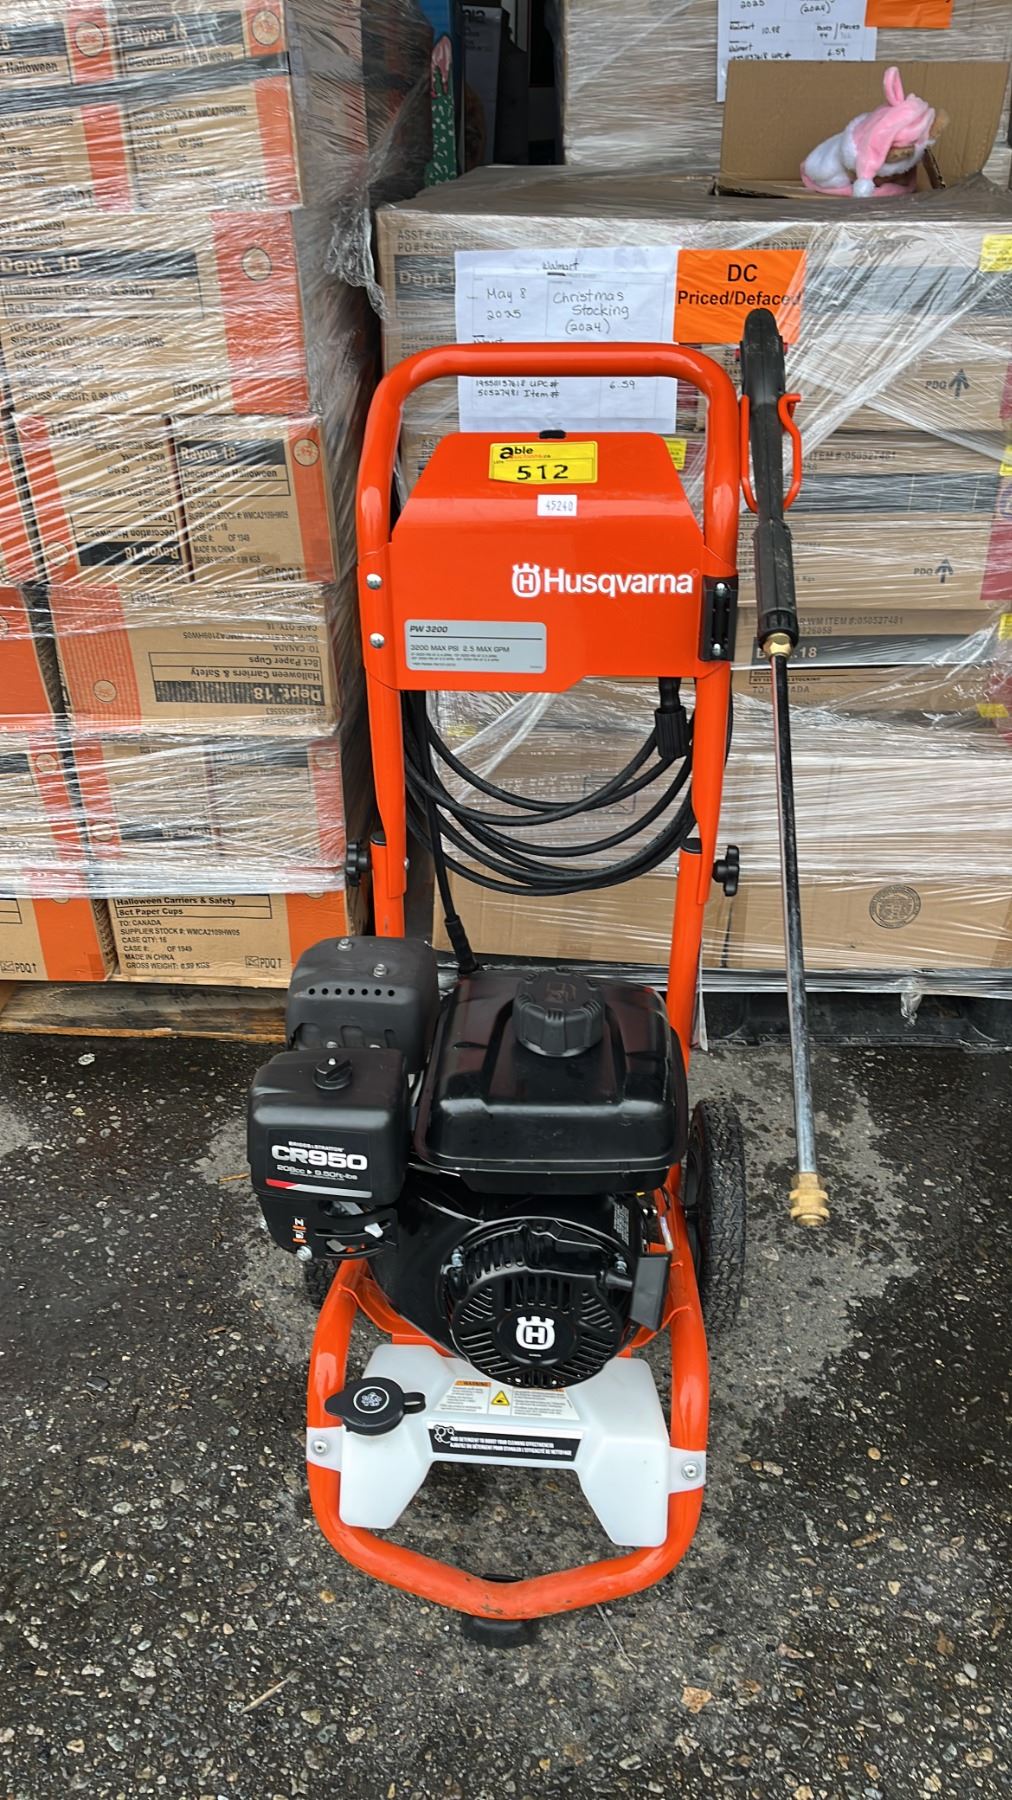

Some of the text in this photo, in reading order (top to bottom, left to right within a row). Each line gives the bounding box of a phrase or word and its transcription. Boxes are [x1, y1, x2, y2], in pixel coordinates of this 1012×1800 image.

[542, 258, 579, 271] Walmart
[727, 263, 758, 282] DC
[487, 287, 625, 304] May 8 Christmas
[486, 304, 630, 321] 2025 Stocking
[529, 380, 548, 388] UPC
[609, 379, 636, 390] 6.59
[523, 388, 549, 399] Item
[499, 446, 534, 460] able
[516, 464, 569, 481] 512
[545, 500, 574, 512] 45240
[544, 568, 693, 597] Husqvarna
[409, 625, 424, 633] PW
[410, 644, 429, 652] 3200
[248, 656, 272, 665] Cups
[275, 658, 301, 667] Paper
[191, 667, 321, 681] Safety & Carriers Halloween
[253, 686, 322, 702] 18 Dept.
[117, 896, 236, 906] Halloween Carriers & Safety
[119, 908, 184, 918] 8ct Paper Cups
[120, 928, 154, 936] SUPPLIER
[155, 928, 178, 936] STOCK
[122, 936, 141, 944] CASE
[167, 945, 177, 953] OF
[125, 953, 145, 961] MADE
[126, 962, 150, 970] GROSS
[196, 962, 210, 970] KGS
[271, 1145, 367, 1170] CR950
